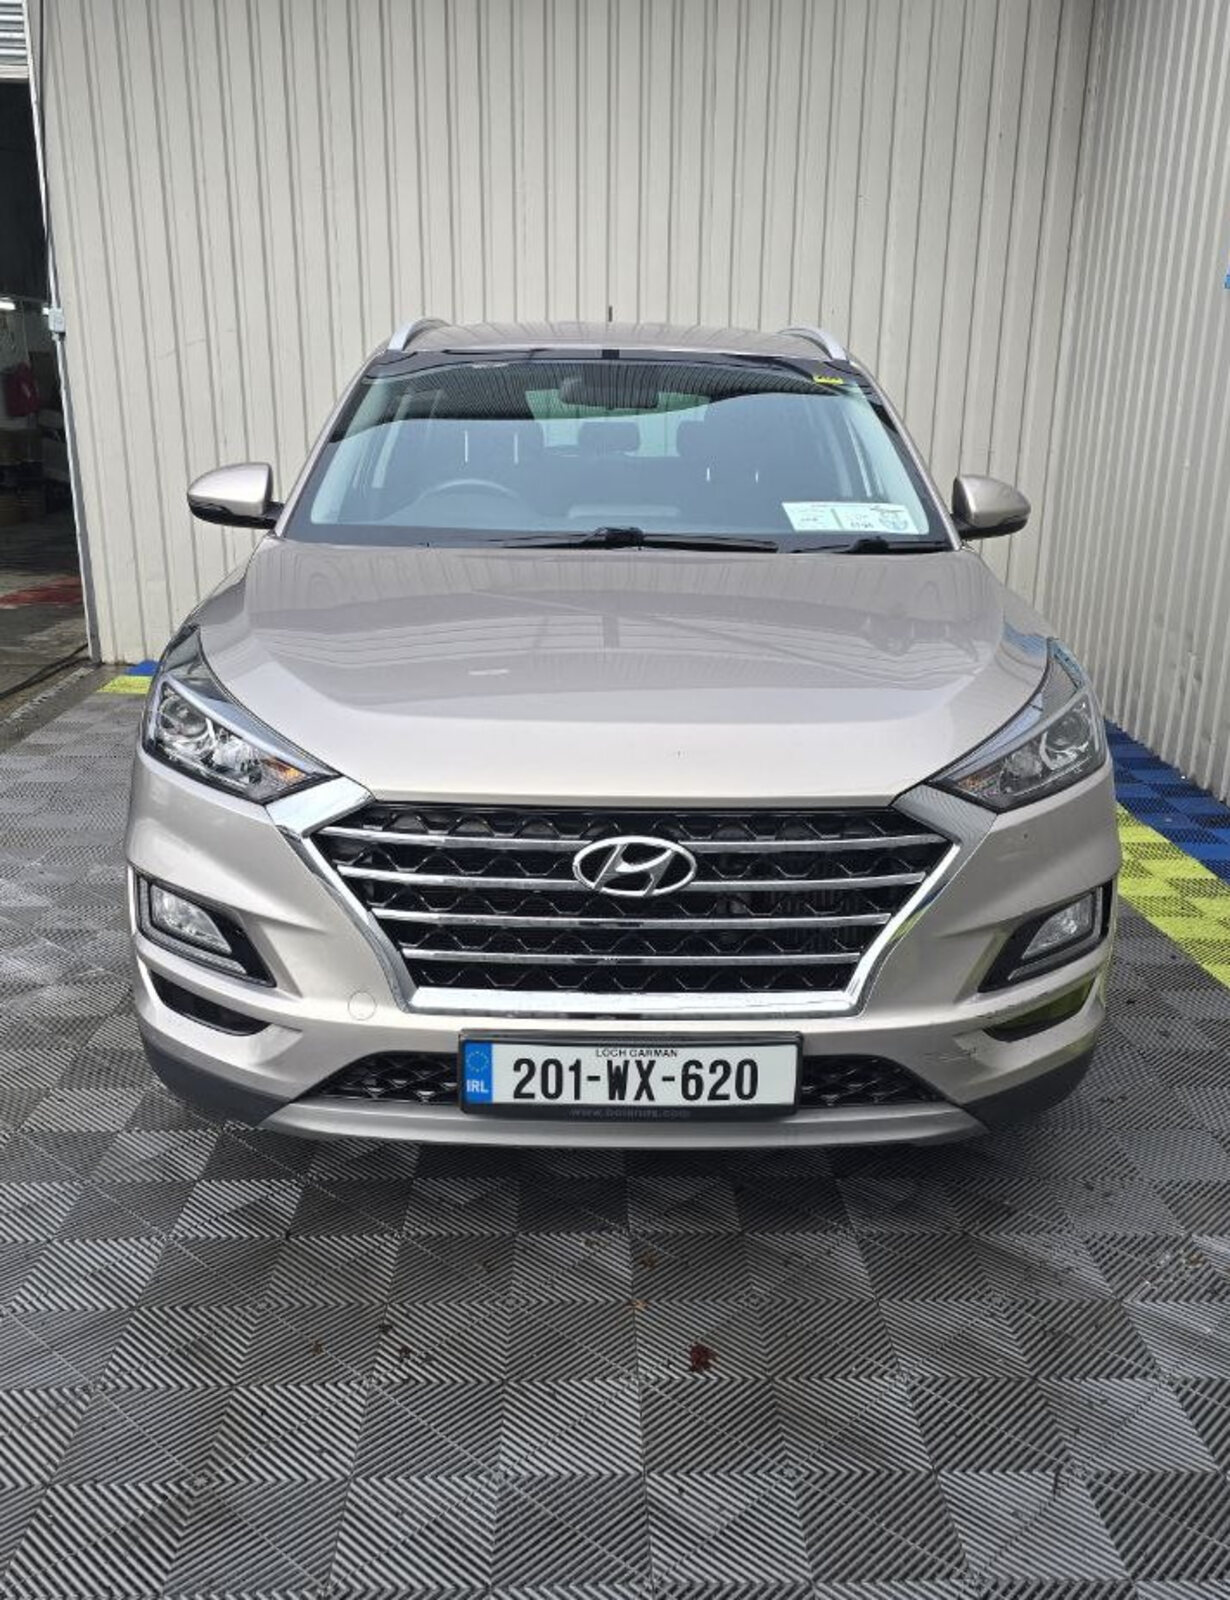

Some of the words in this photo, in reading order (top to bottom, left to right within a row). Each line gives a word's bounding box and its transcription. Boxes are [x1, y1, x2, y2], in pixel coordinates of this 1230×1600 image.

[596, 1049, 627, 1057] LOCH
[629, 1049, 678, 1057] GARMAN
[513, 1058, 759, 1101] 201-WX-620
[466, 1080, 489, 1093] IRL
